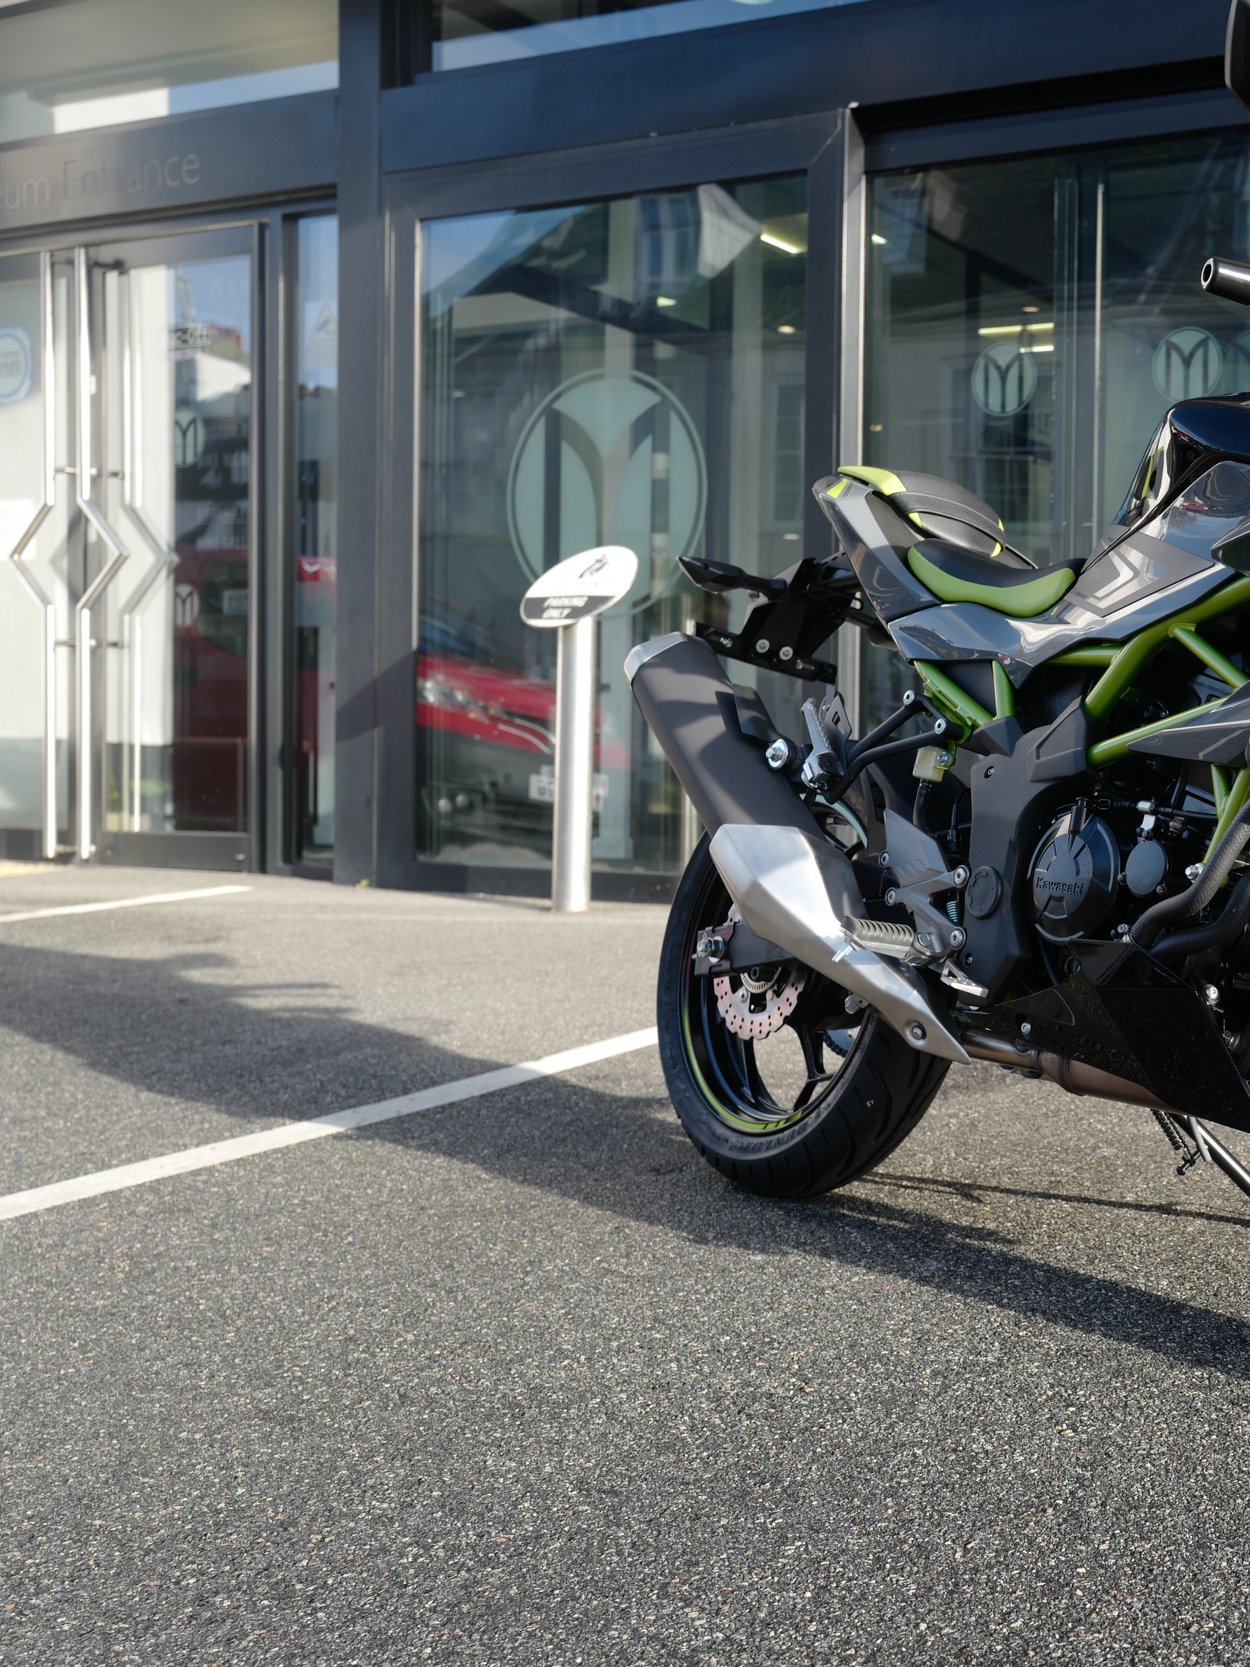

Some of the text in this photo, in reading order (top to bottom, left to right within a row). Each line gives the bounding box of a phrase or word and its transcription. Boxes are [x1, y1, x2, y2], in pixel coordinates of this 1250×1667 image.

[0, 152, 201, 210] um Entrance
[1035, 876, 1085, 896] Kawasaki
